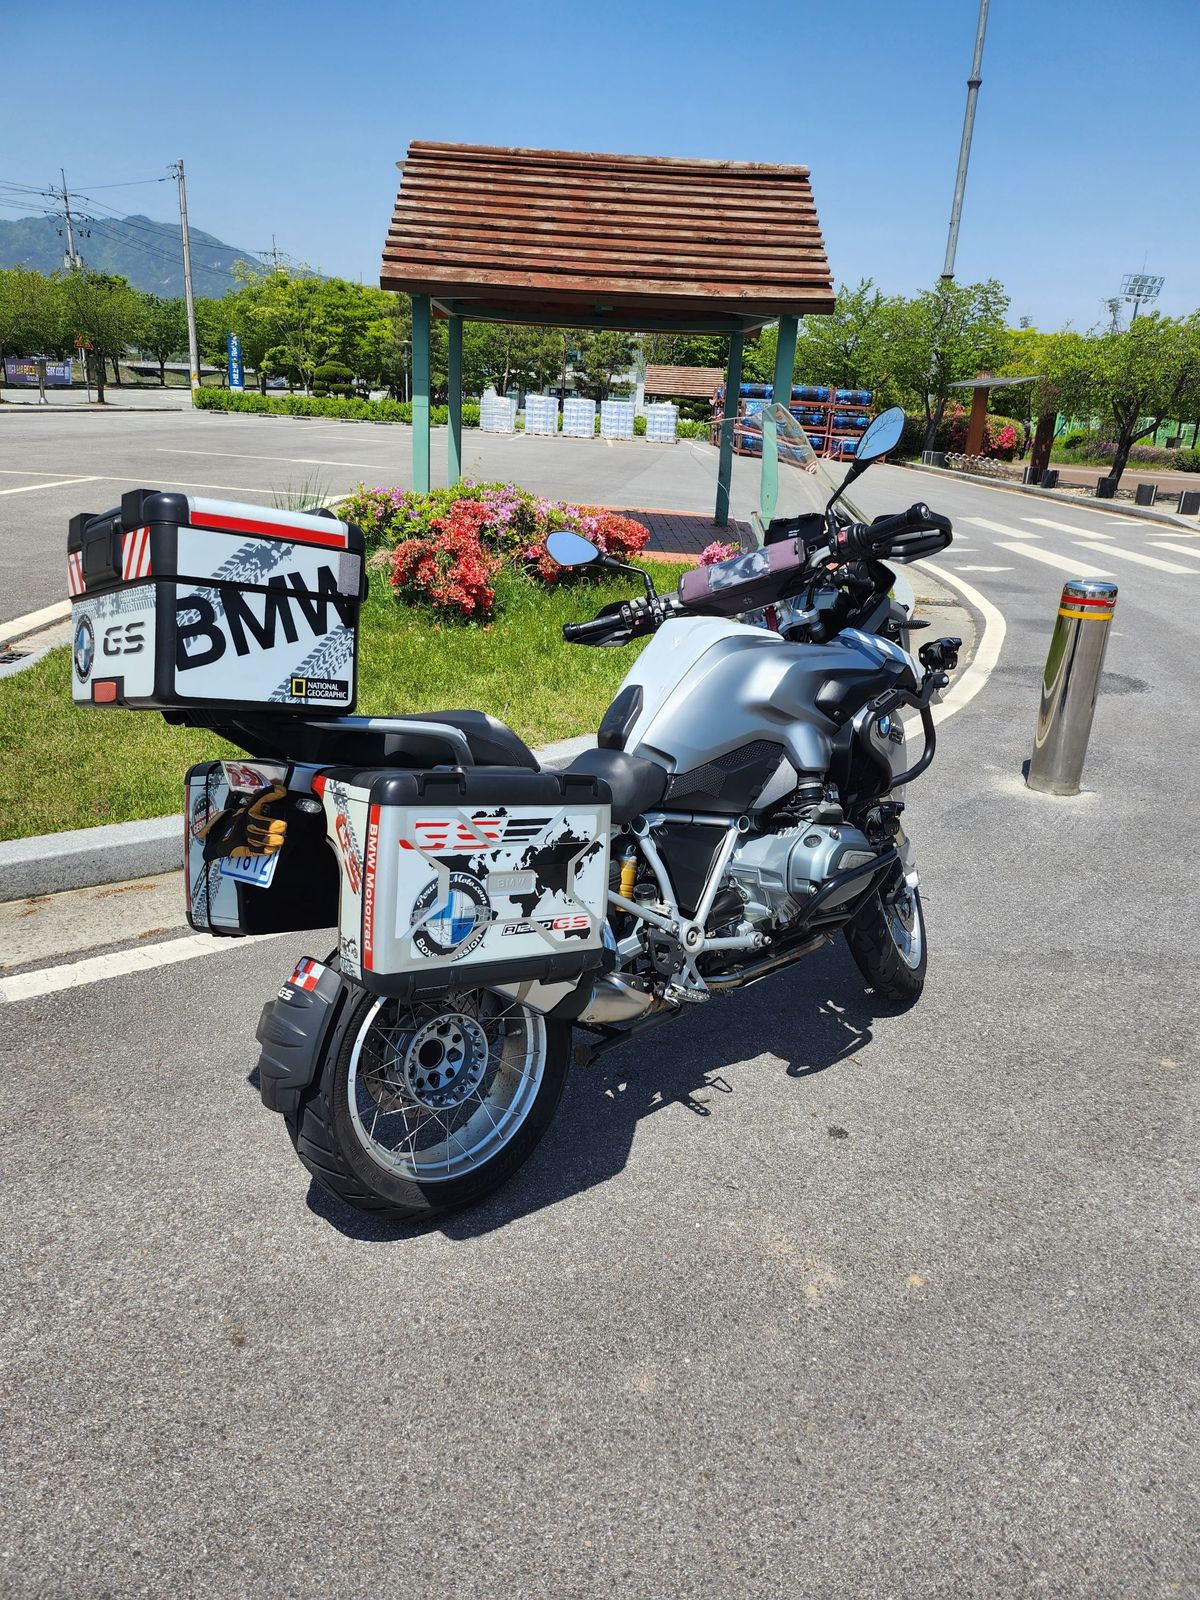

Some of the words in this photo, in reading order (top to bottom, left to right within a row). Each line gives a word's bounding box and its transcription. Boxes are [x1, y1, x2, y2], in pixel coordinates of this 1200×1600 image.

[175, 565, 356, 671] BMW
[102, 620, 146, 657] GS
[307, 682, 339, 691] NATIONAL
[307, 689, 347, 699] GEOGRAPHIC
[366, 823, 379, 870] BMW
[497, 878, 528, 889] BMW
[363, 872, 376, 952] Motorrad
[278, 986, 295, 1001] GS
